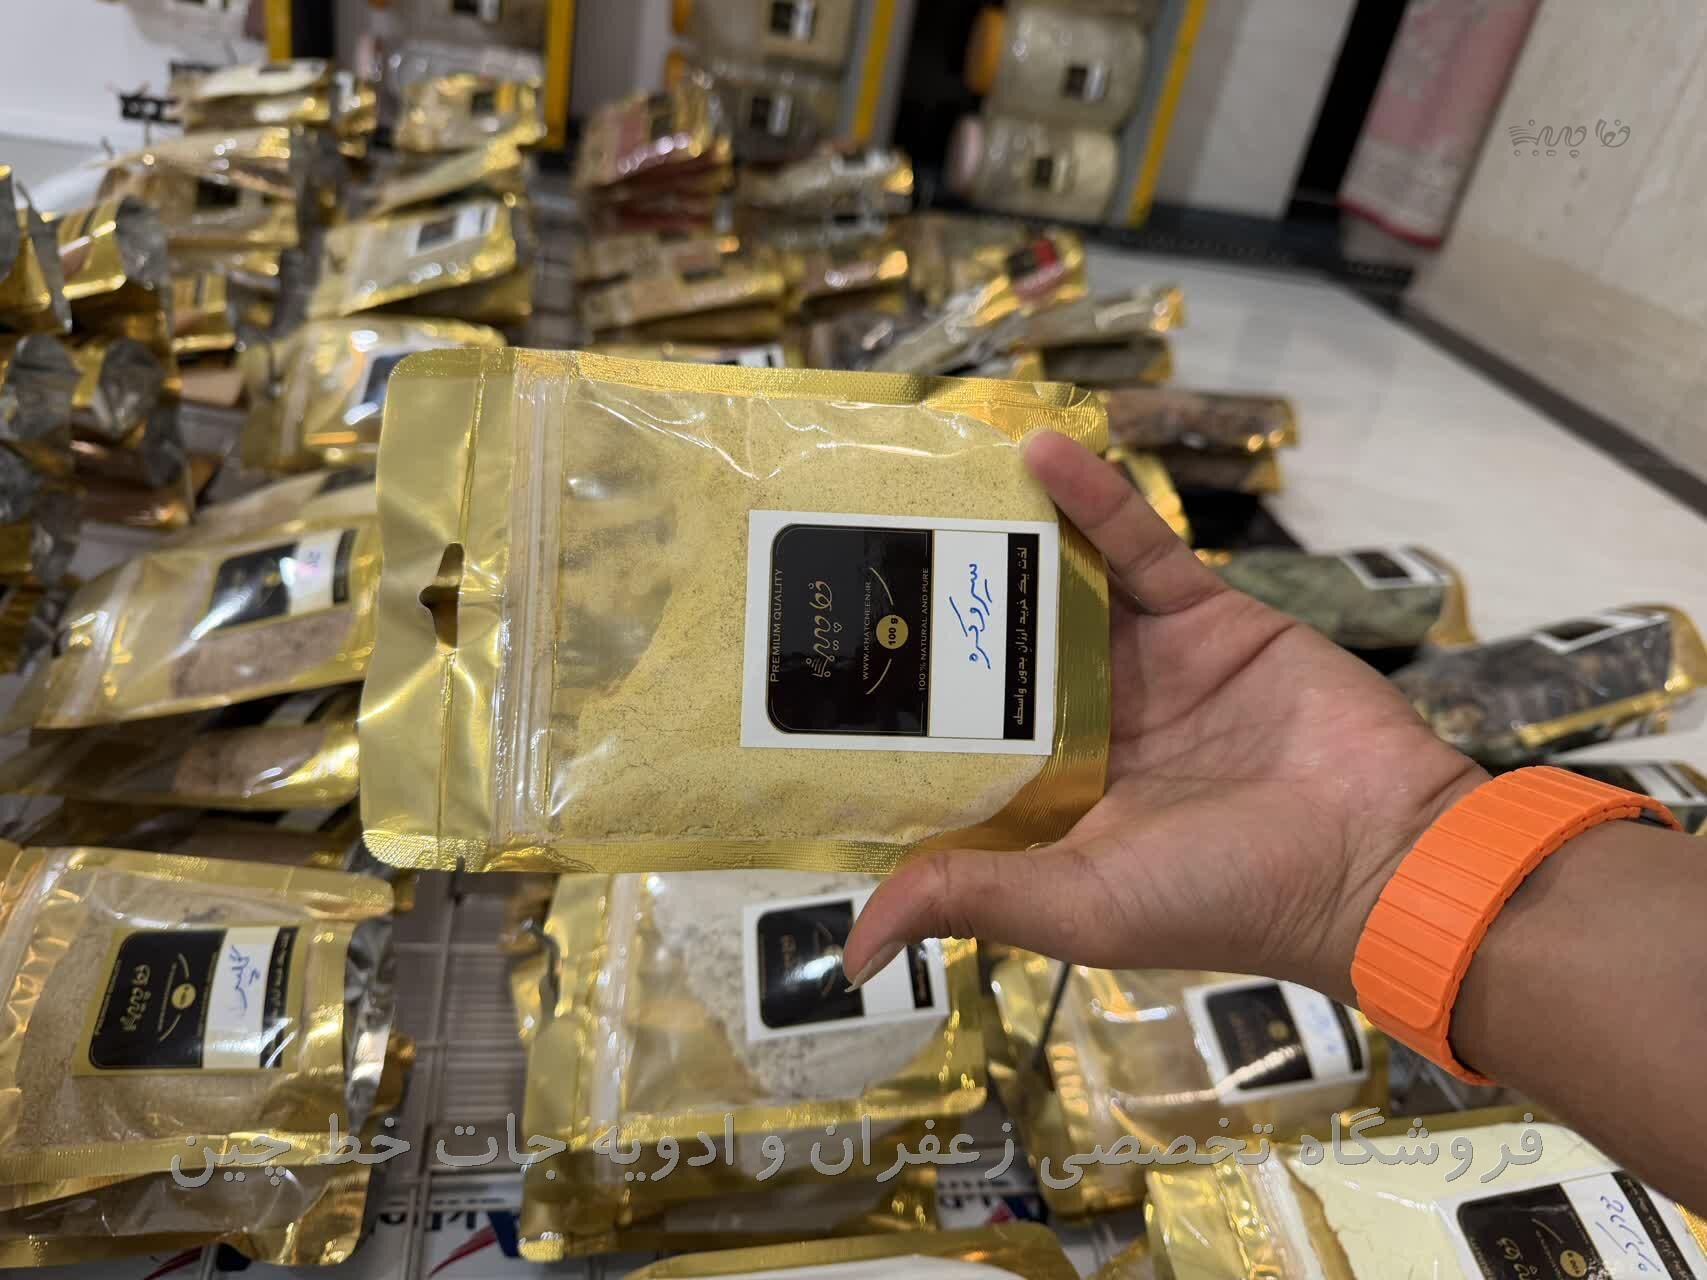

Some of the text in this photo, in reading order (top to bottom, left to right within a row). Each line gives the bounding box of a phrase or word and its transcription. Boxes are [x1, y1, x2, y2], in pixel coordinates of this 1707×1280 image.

[1016, 547, 1028, 570] لذت
[1018, 572, 1029, 595] یک
[921, 593, 929, 615] AND
[1016, 599, 1029, 625] خرید
[770, 568, 784, 683] PREMIUM QUALITY
[862, 581, 872, 681] WWW.KHATCHEEN.IR
[888, 617, 899, 646] 100 g
[920, 616, 928, 661] NATURAL
[918, 673, 927, 691] 100
[1018, 657, 1028, 684] بدون
[1013, 687, 1028, 726] واسطه
